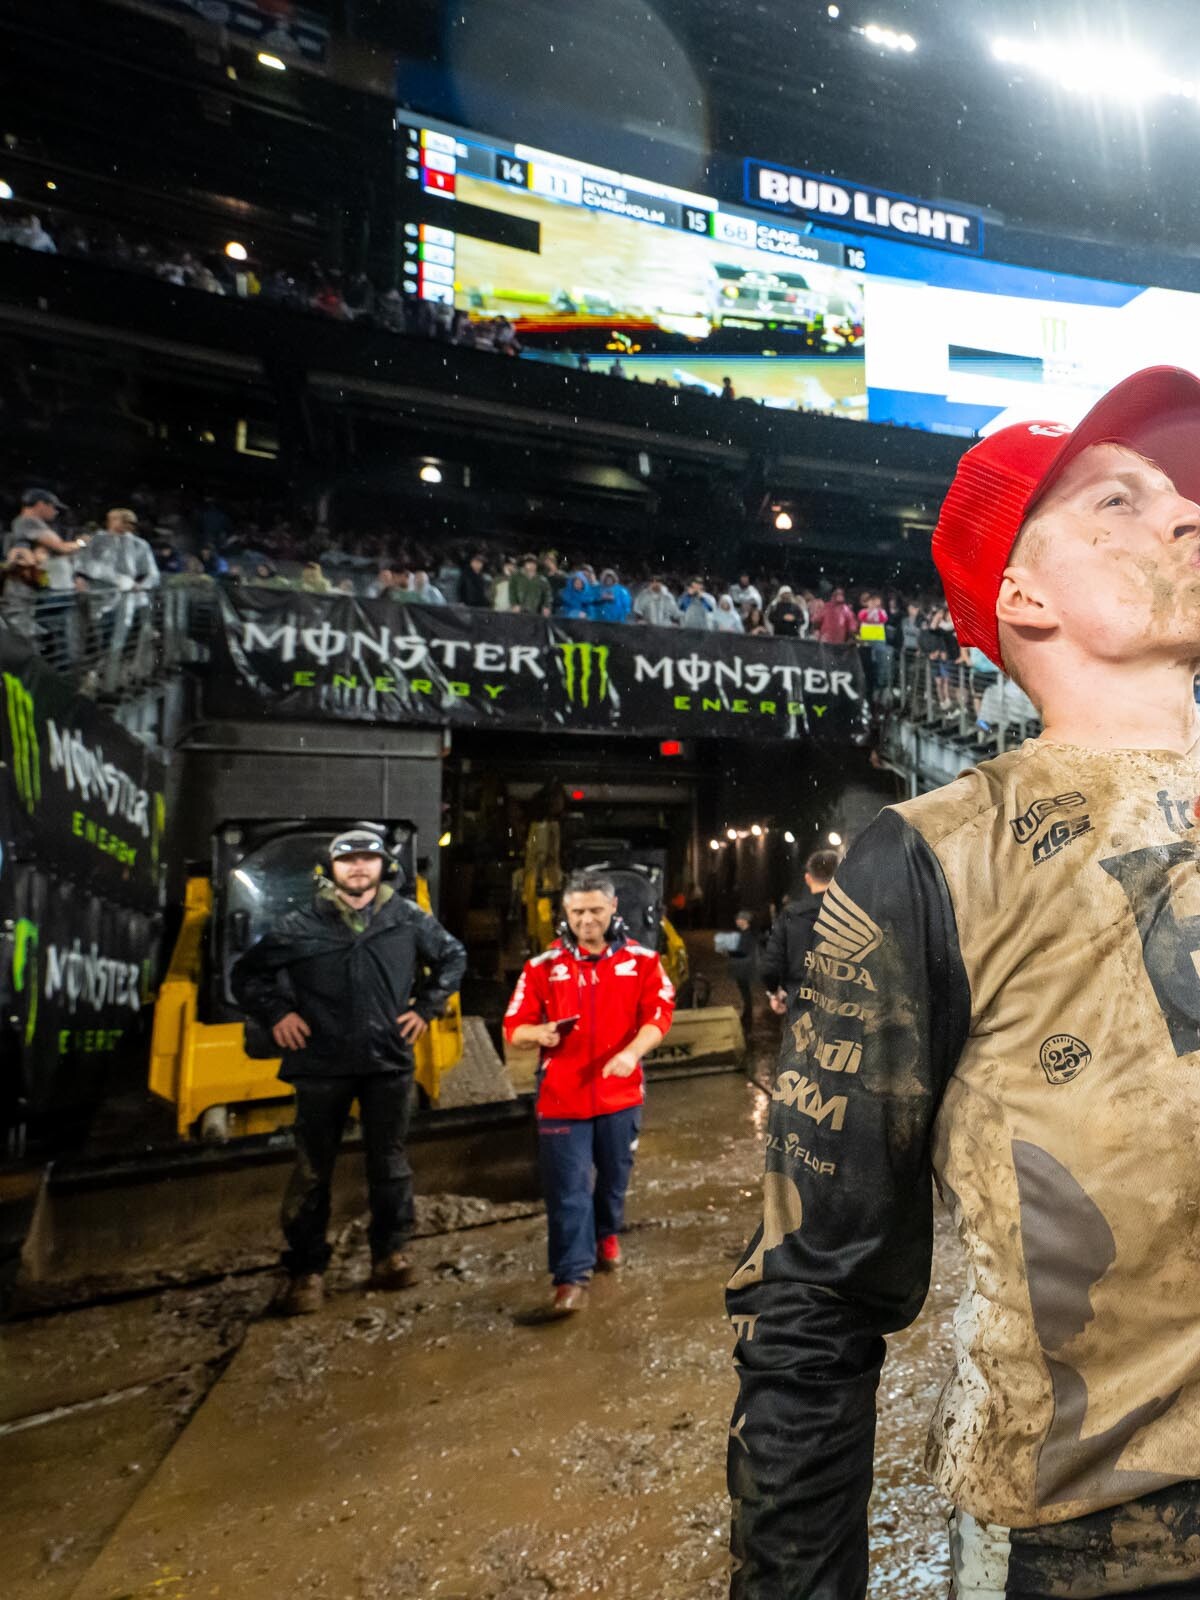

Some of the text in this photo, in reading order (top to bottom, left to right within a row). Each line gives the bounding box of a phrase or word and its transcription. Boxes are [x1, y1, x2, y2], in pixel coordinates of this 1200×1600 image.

[502, 159, 525, 183] 14
[686, 210, 707, 232] 15
[758, 168, 970, 245] BUD LIGHT
[847, 249, 866, 269] 16
[243, 621, 546, 679] MONSTER
[293, 671, 505, 699] ENERGY
[634, 653, 860, 700] MONSTER
[674, 696, 828, 717] ENERGY
[46, 718, 149, 838] MONSTER
[1048, 1040, 1081, 1072] 25
